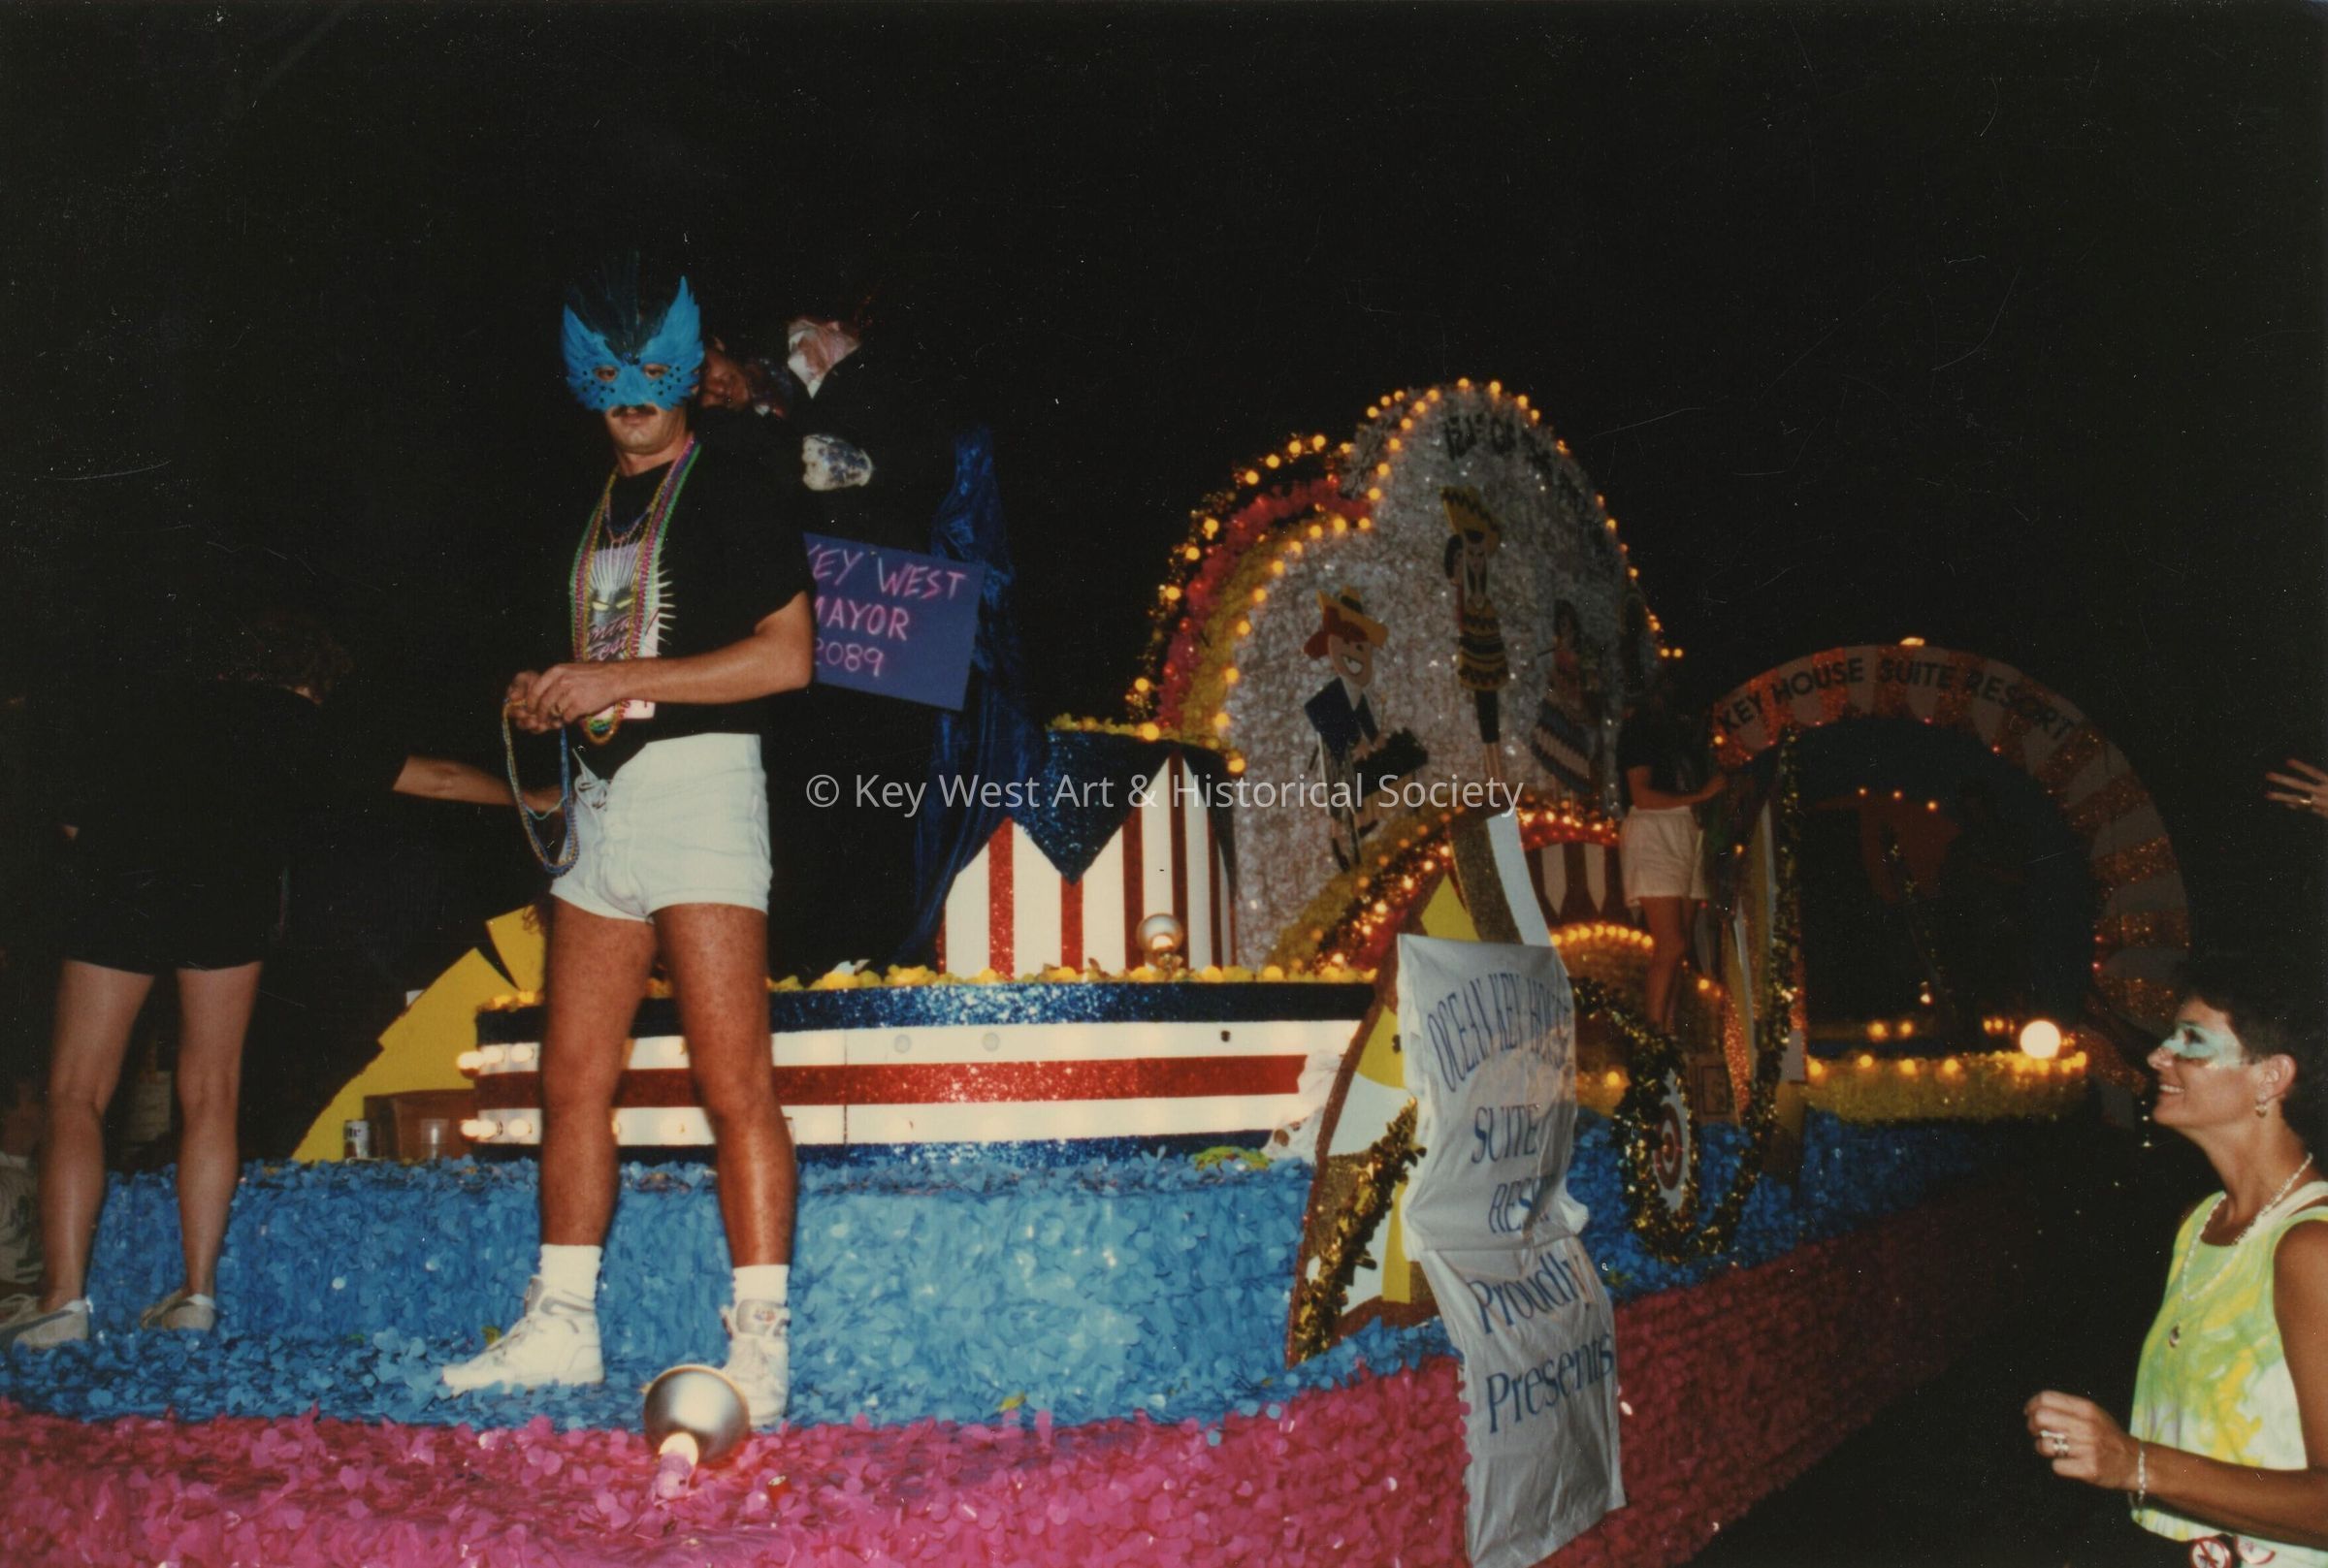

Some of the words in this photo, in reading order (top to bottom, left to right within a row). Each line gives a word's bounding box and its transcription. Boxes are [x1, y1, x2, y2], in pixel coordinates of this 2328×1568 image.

[807, 544, 864, 586] EY
[877, 557, 967, 600] WEST
[1721, 689, 1765, 734] KEY
[1771, 657, 1864, 705] HOUSE
[1880, 657, 1957, 689] SUITE
[1965, 670, 2075, 740] RESORT
[1428, 977, 1492, 1093] OCEAN
[1488, 973, 1524, 1051] KEY
[1471, 1103, 1540, 1164] SUITE
[1489, 1173, 1554, 1234] RES
[1467, 1252, 1590, 1334] Proudly
[1486, 1333, 1613, 1434] Presents
